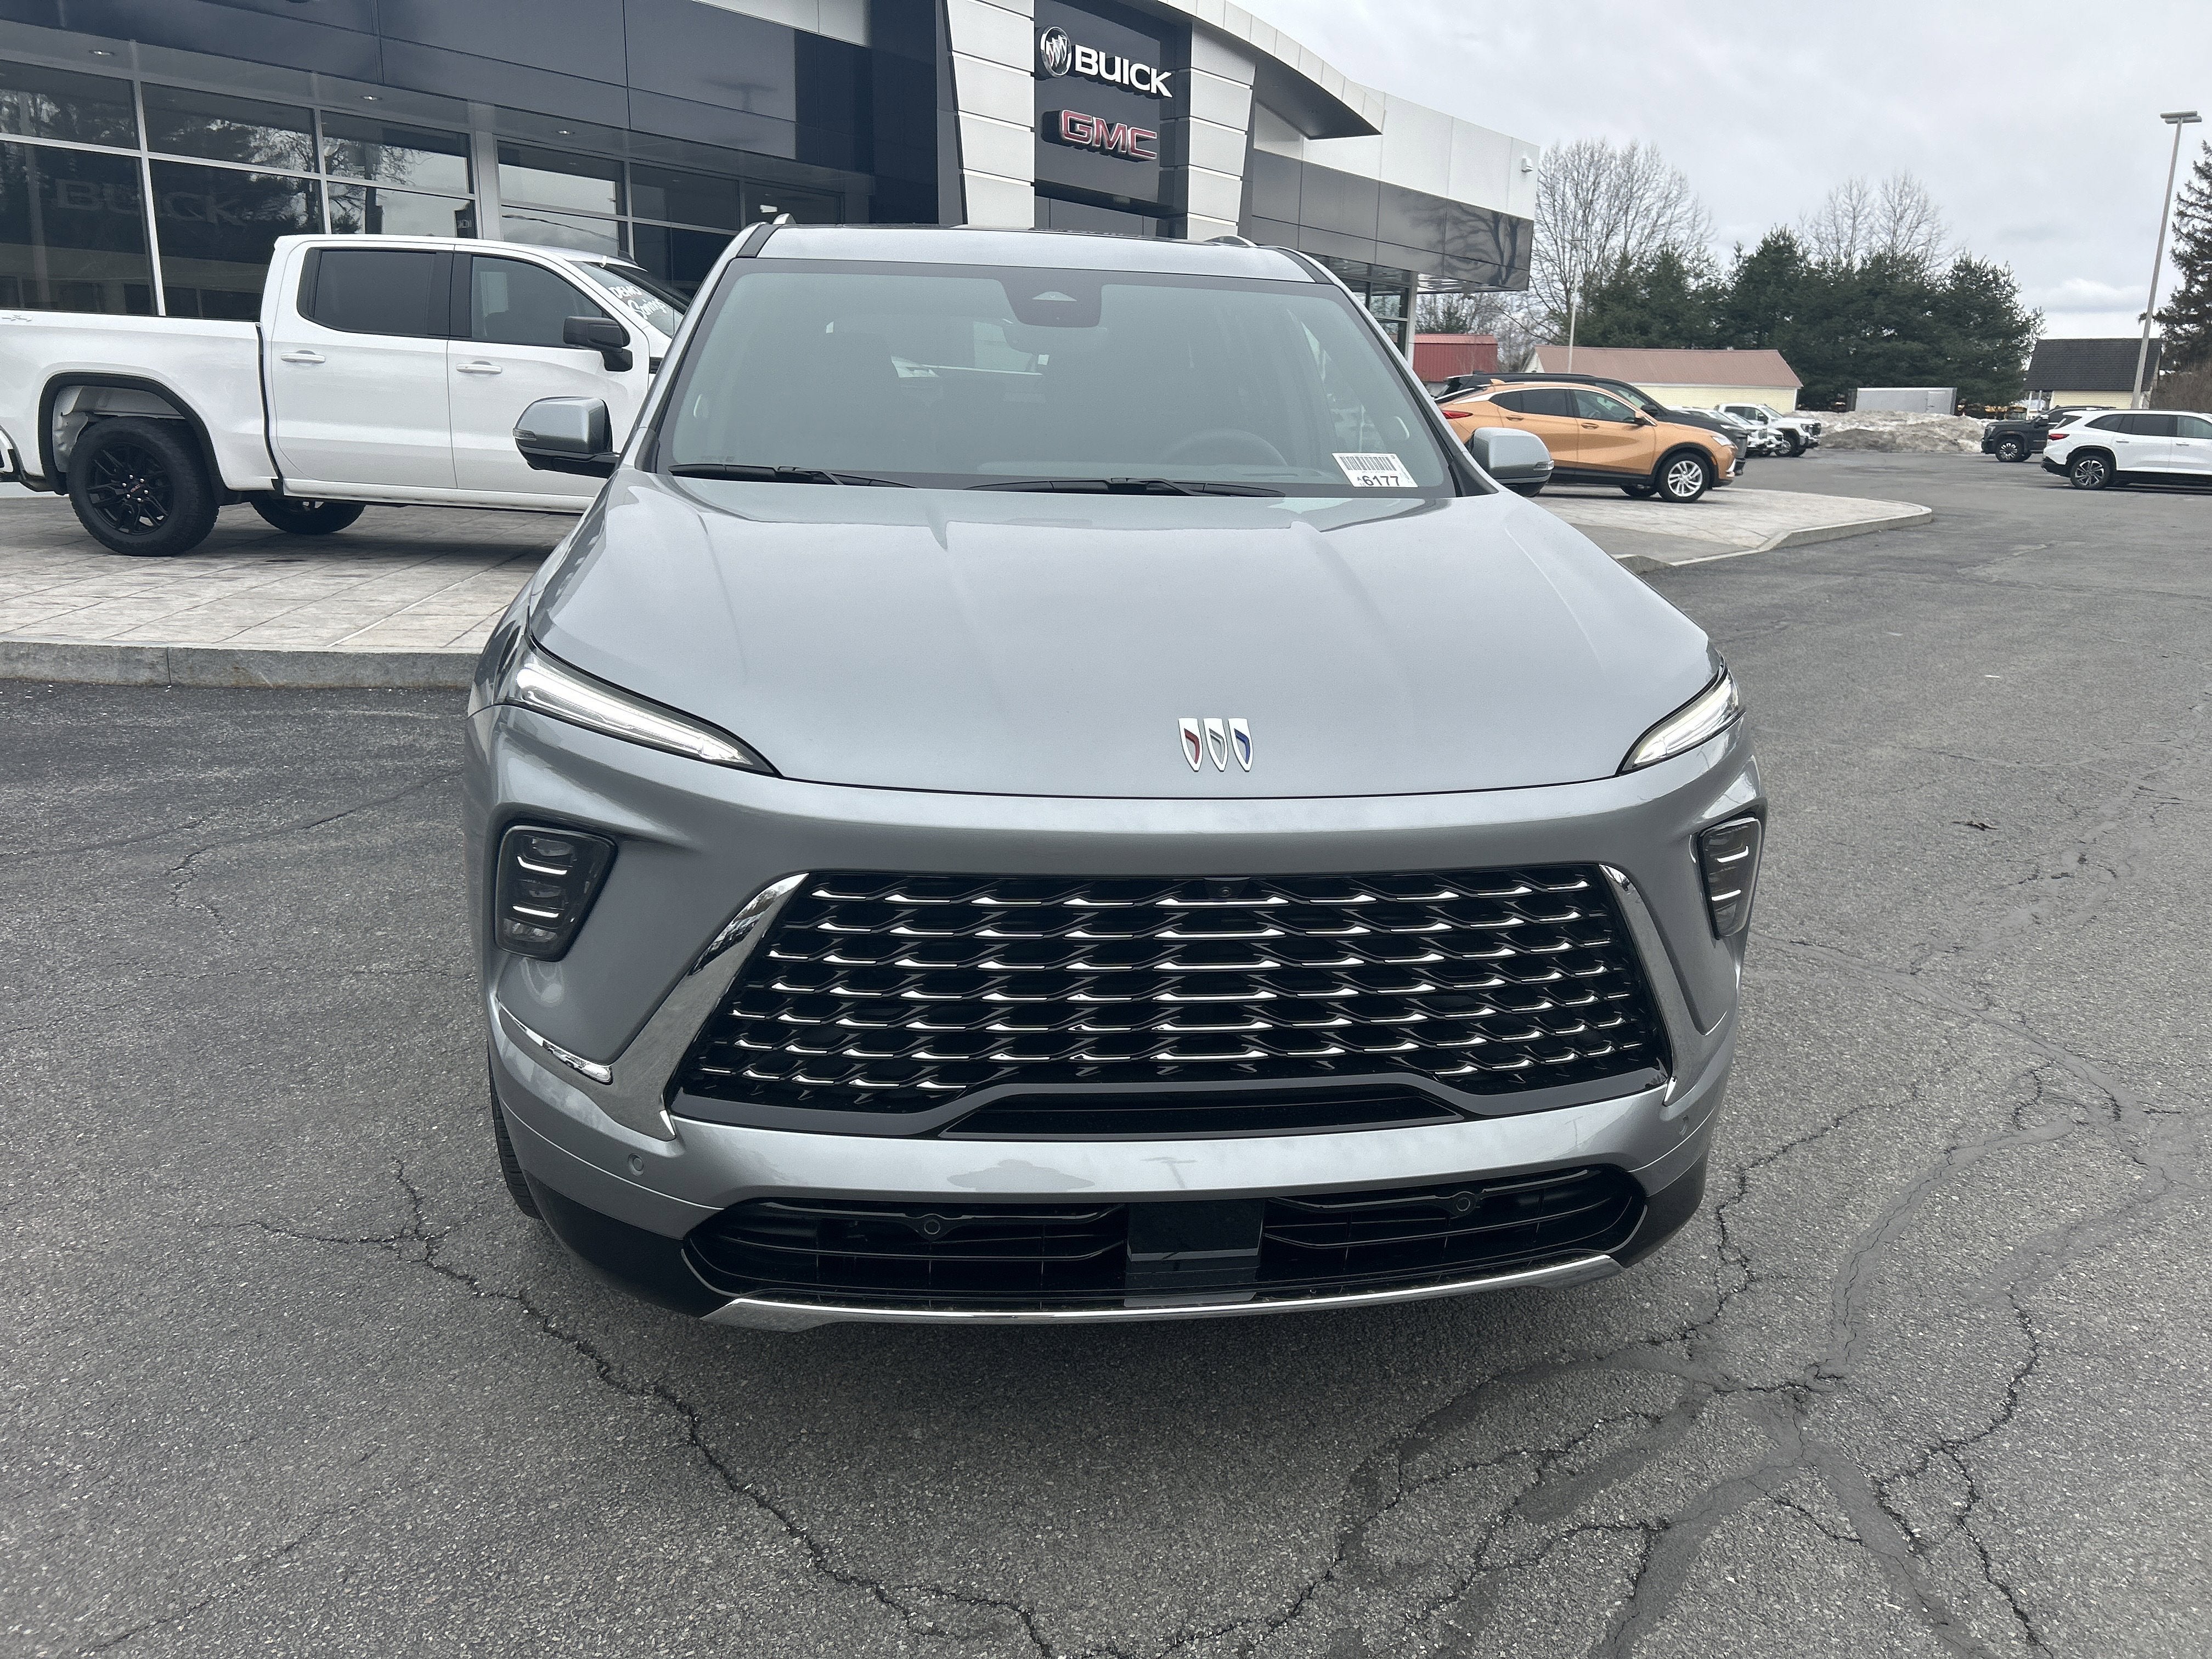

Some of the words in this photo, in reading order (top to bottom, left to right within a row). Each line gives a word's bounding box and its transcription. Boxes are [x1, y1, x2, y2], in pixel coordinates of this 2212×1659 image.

[1075, 44, 1172, 98] BUICK
[1061, 110, 1158, 159] GMC
[608, 285, 642, 299] DEMO
[628, 298, 667, 319] Savings
[1362, 475, 1400, 487] 6177
